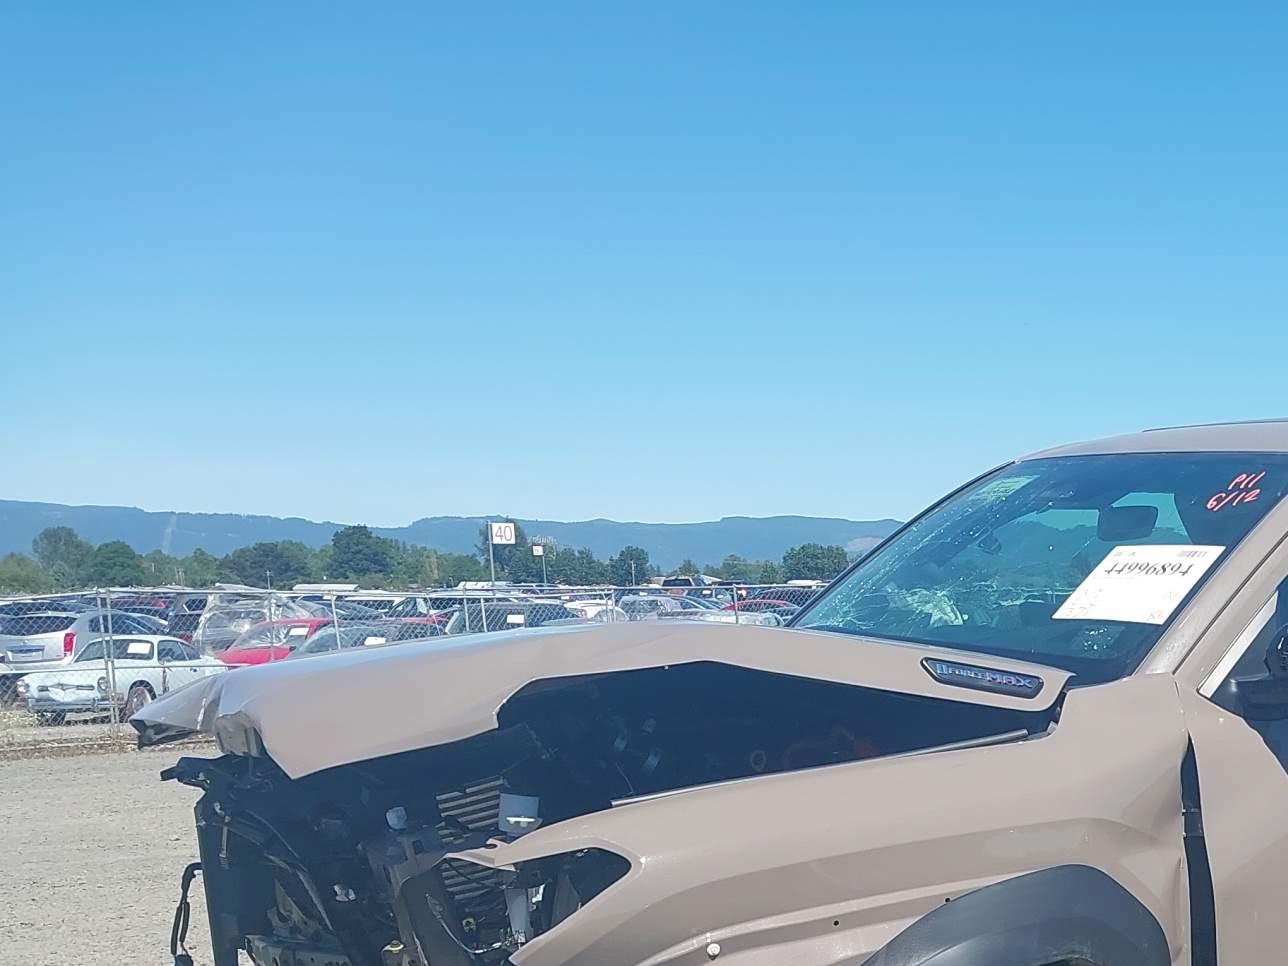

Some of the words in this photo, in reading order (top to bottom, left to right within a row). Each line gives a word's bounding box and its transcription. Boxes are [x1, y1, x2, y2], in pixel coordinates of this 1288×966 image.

[1206, 488, 1261, 511] 6/12
[495, 525, 513, 541] 40
[1104, 562, 1195, 577] 44996894
